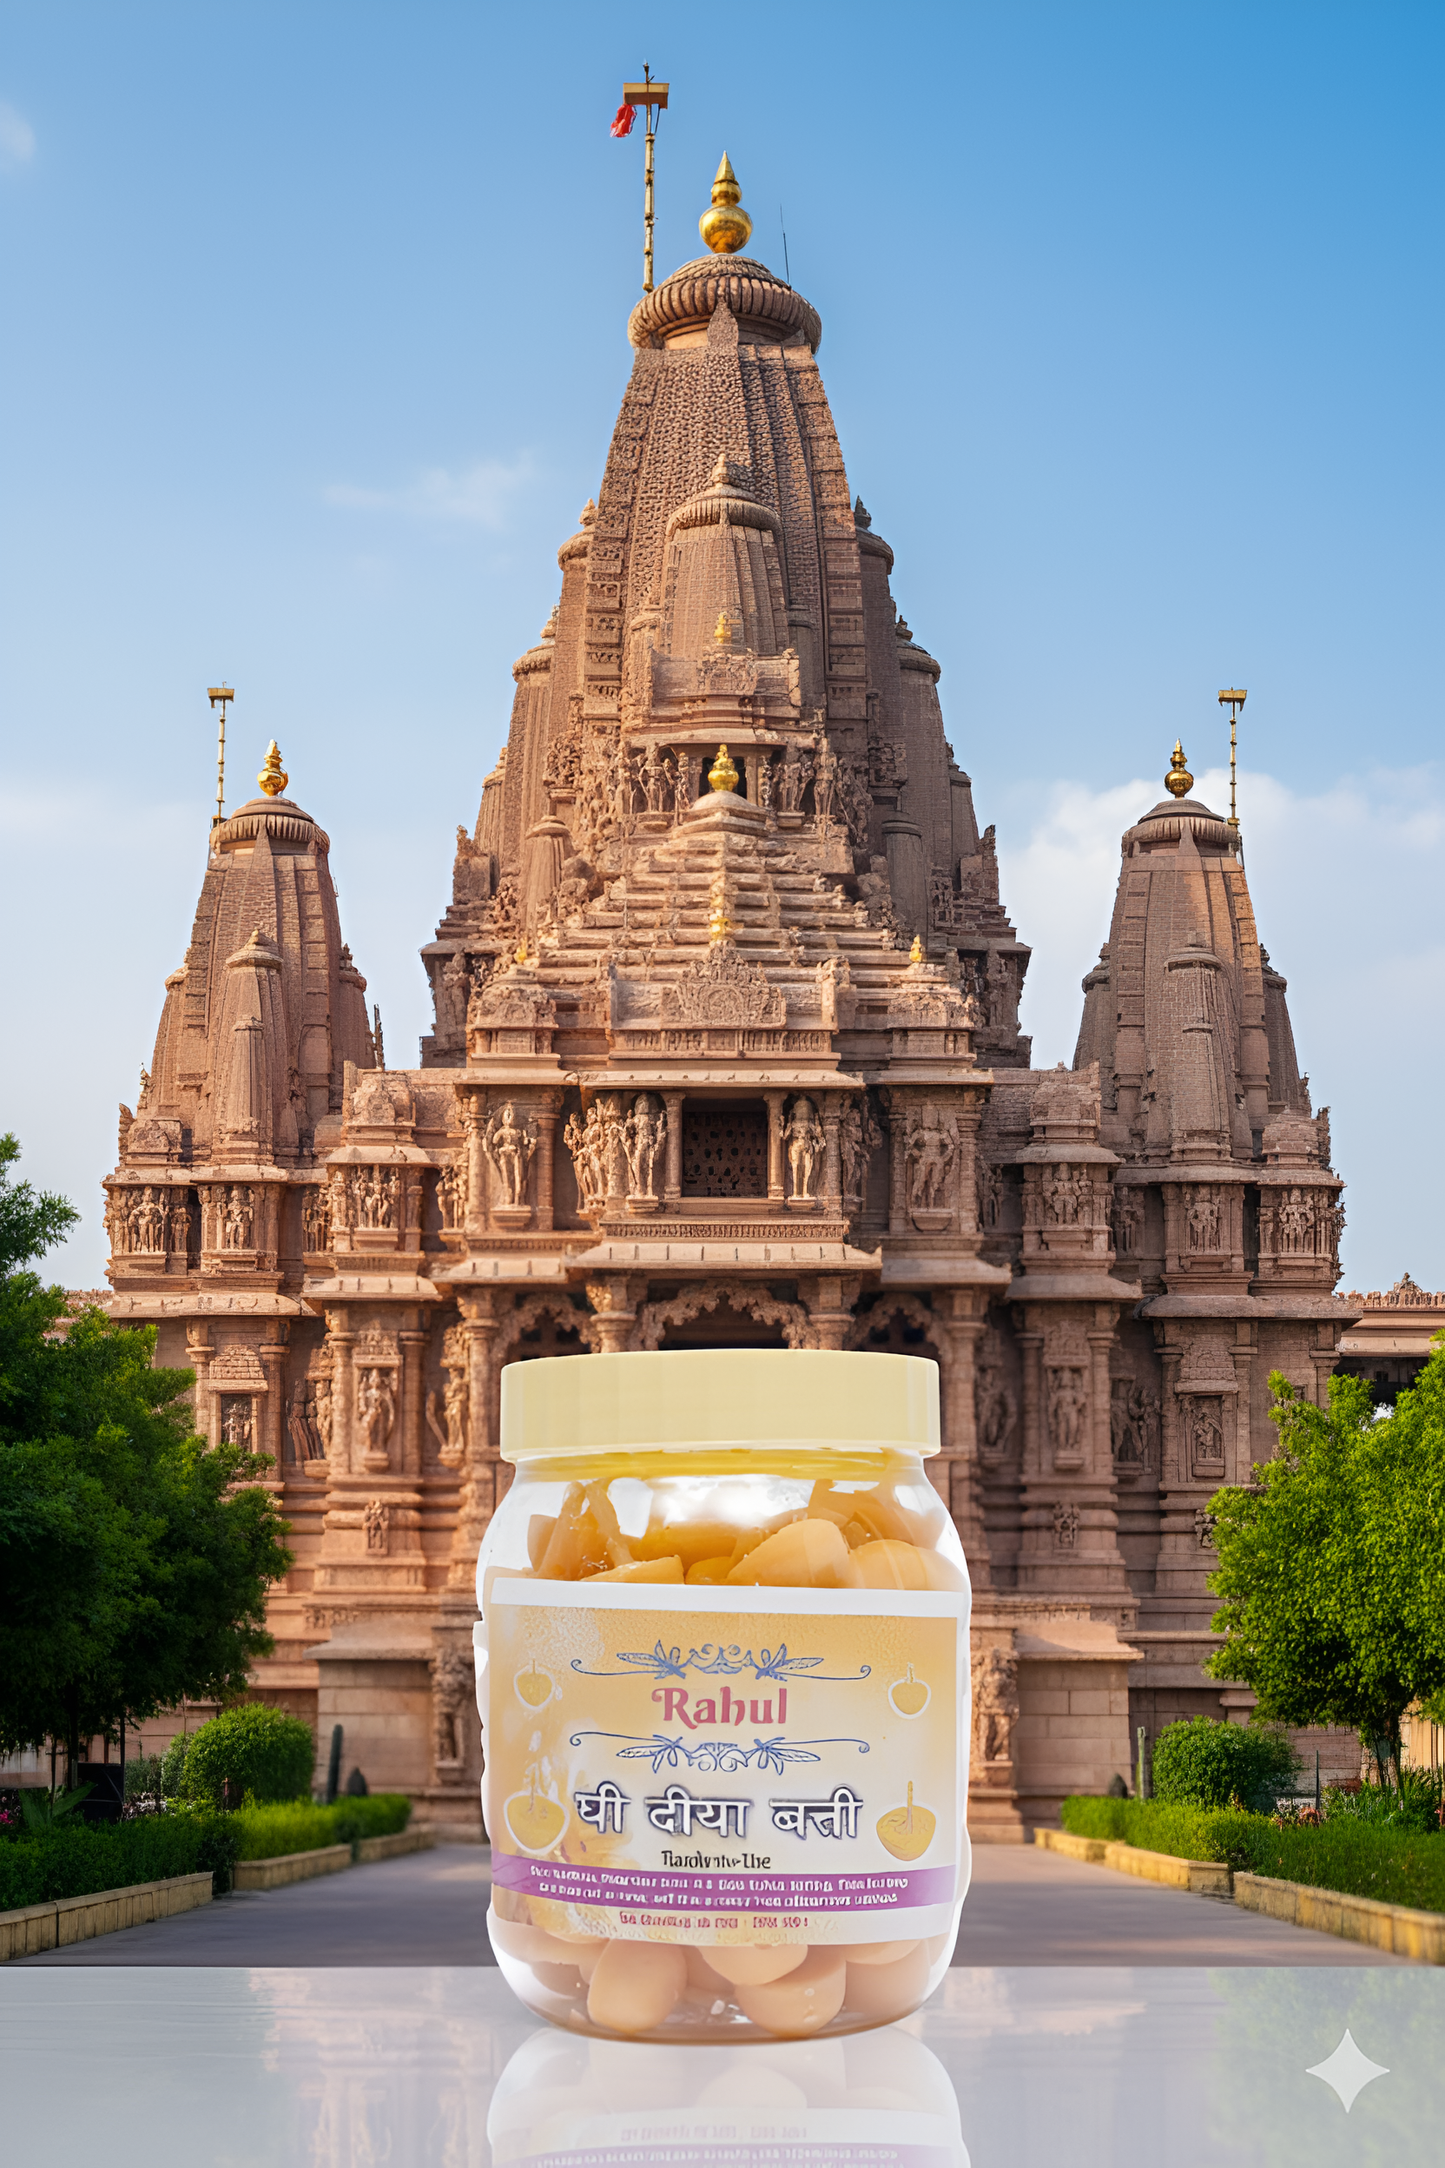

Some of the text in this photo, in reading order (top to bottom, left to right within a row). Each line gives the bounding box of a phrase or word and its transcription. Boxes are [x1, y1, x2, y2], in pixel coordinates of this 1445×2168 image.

[651, 1685, 788, 1730] Rahul
[643, 1784, 754, 1838] दीया
[768, 1784, 864, 1840] बत्ती
